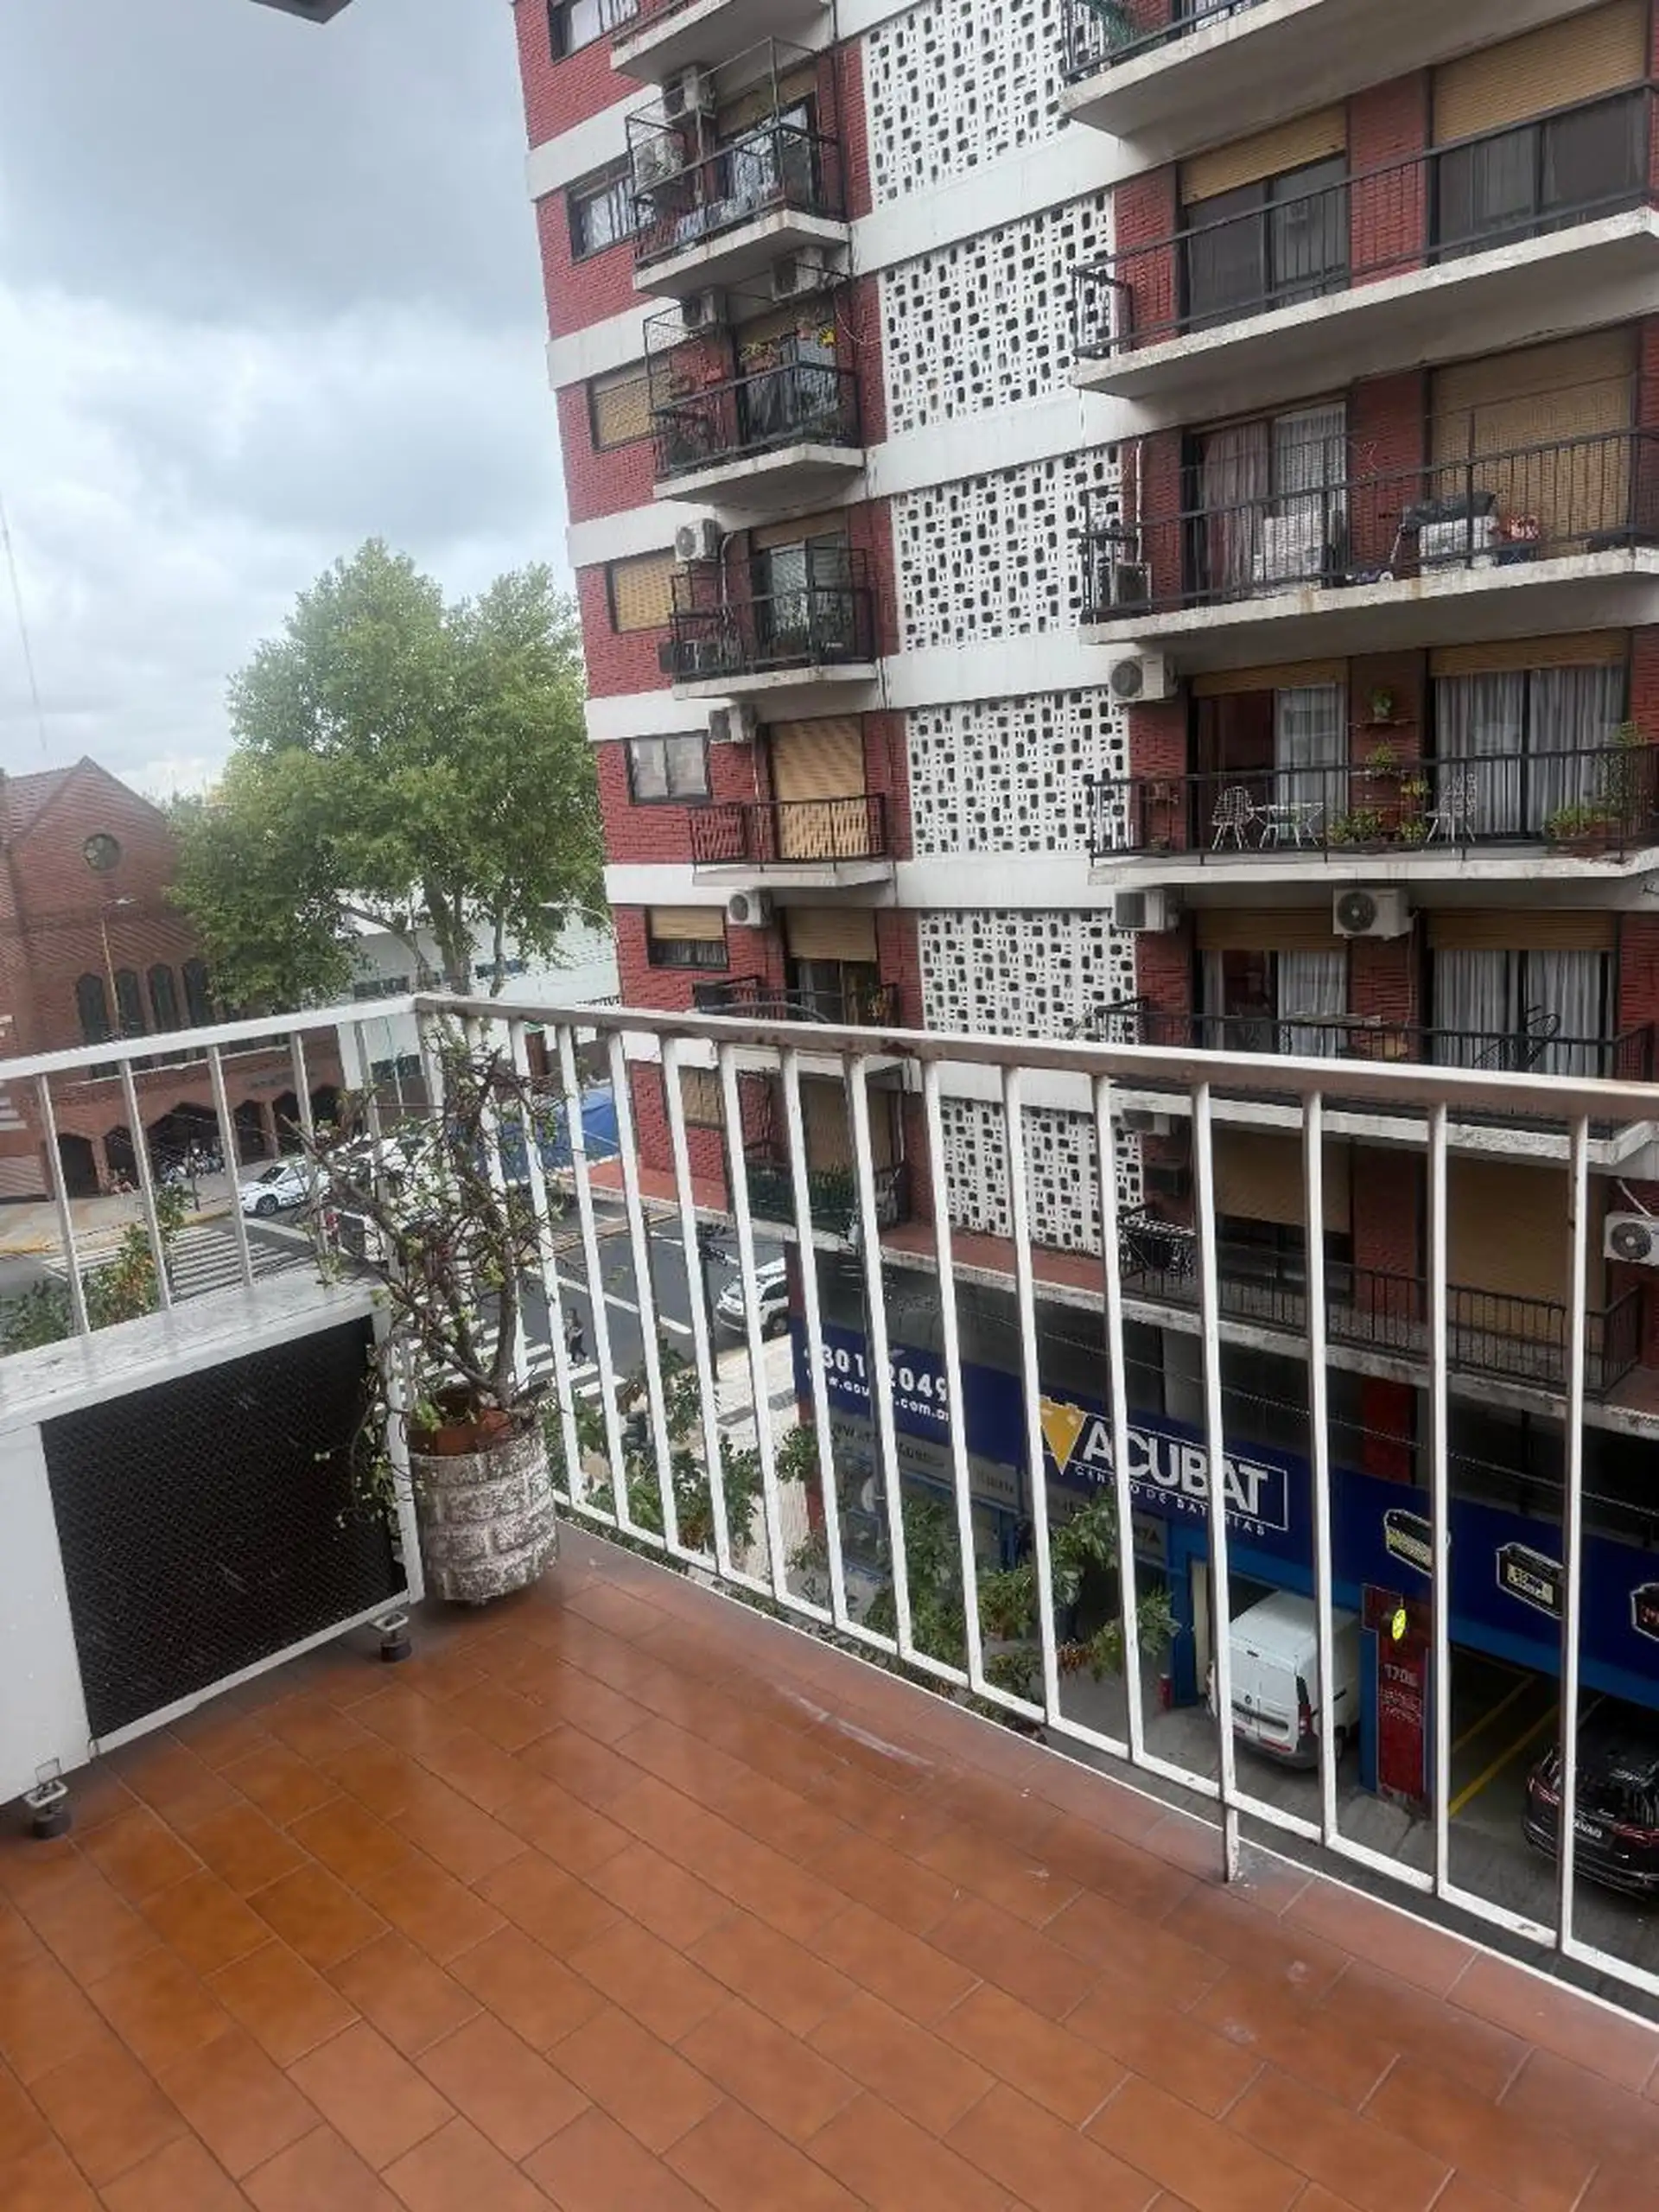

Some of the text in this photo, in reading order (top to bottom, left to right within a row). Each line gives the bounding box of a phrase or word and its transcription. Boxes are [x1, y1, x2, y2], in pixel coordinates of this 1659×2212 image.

[804, 1344, 865, 1377] 301
[1084, 1421, 1268, 1515] ACUBAT
[1177, 1498, 1265, 1535] BATRIAS
